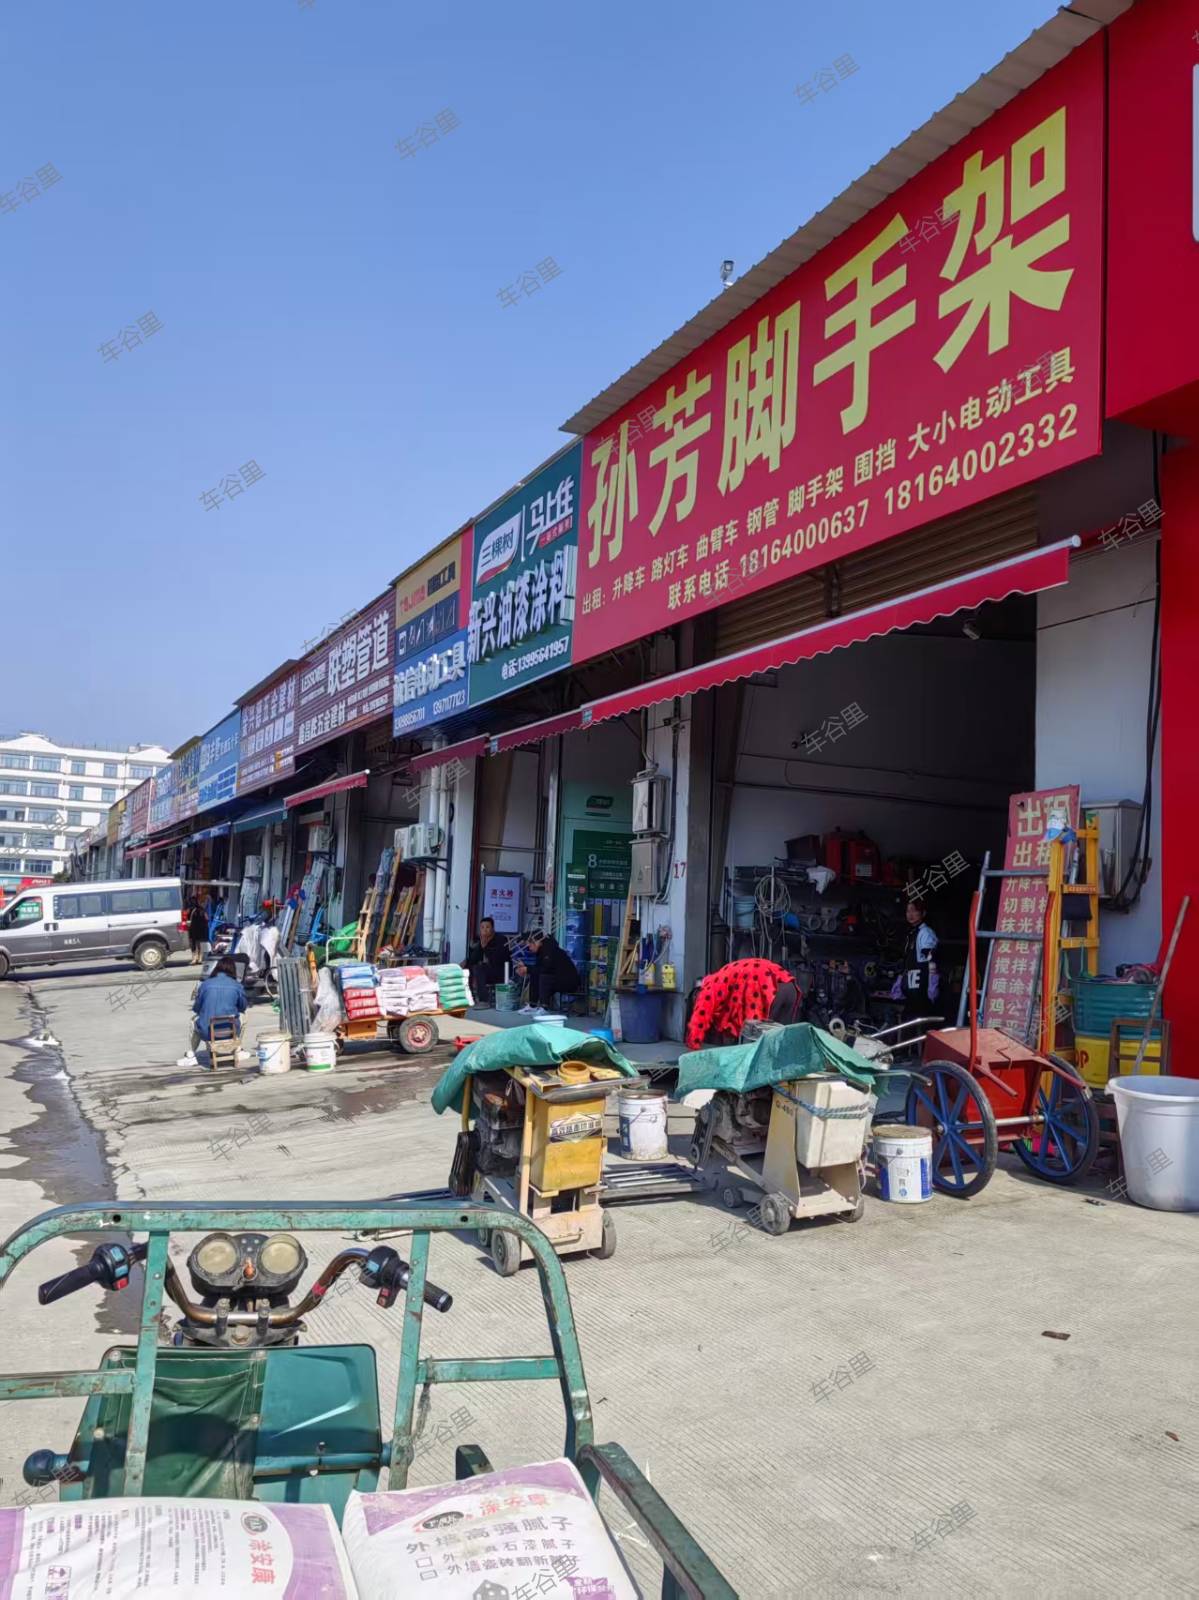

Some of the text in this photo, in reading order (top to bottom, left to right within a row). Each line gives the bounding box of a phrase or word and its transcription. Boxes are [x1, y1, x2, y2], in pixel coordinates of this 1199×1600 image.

[587, 106, 1075, 568] 孙芳脚手架
[612, 556, 646, 603] 升降车
[650, 543, 690, 585] 路灯车
[695, 518, 739, 564] 曲臂车
[746, 501, 780, 537] 钢管
[787, 465, 845, 521] 脚手架
[854, 436, 897, 488] 围挡
[907, 346, 1076, 458] 大小电动工具
[668, 403, 1078, 611] 联系电话 18164000637 18164002332
[481, 526, 514, 569] 三棵树
[328, 609, 389, 697] 联塑管道
[673, 861, 687, 879] 17
[442, 1538, 575, 1562] 外真石漆腻子
